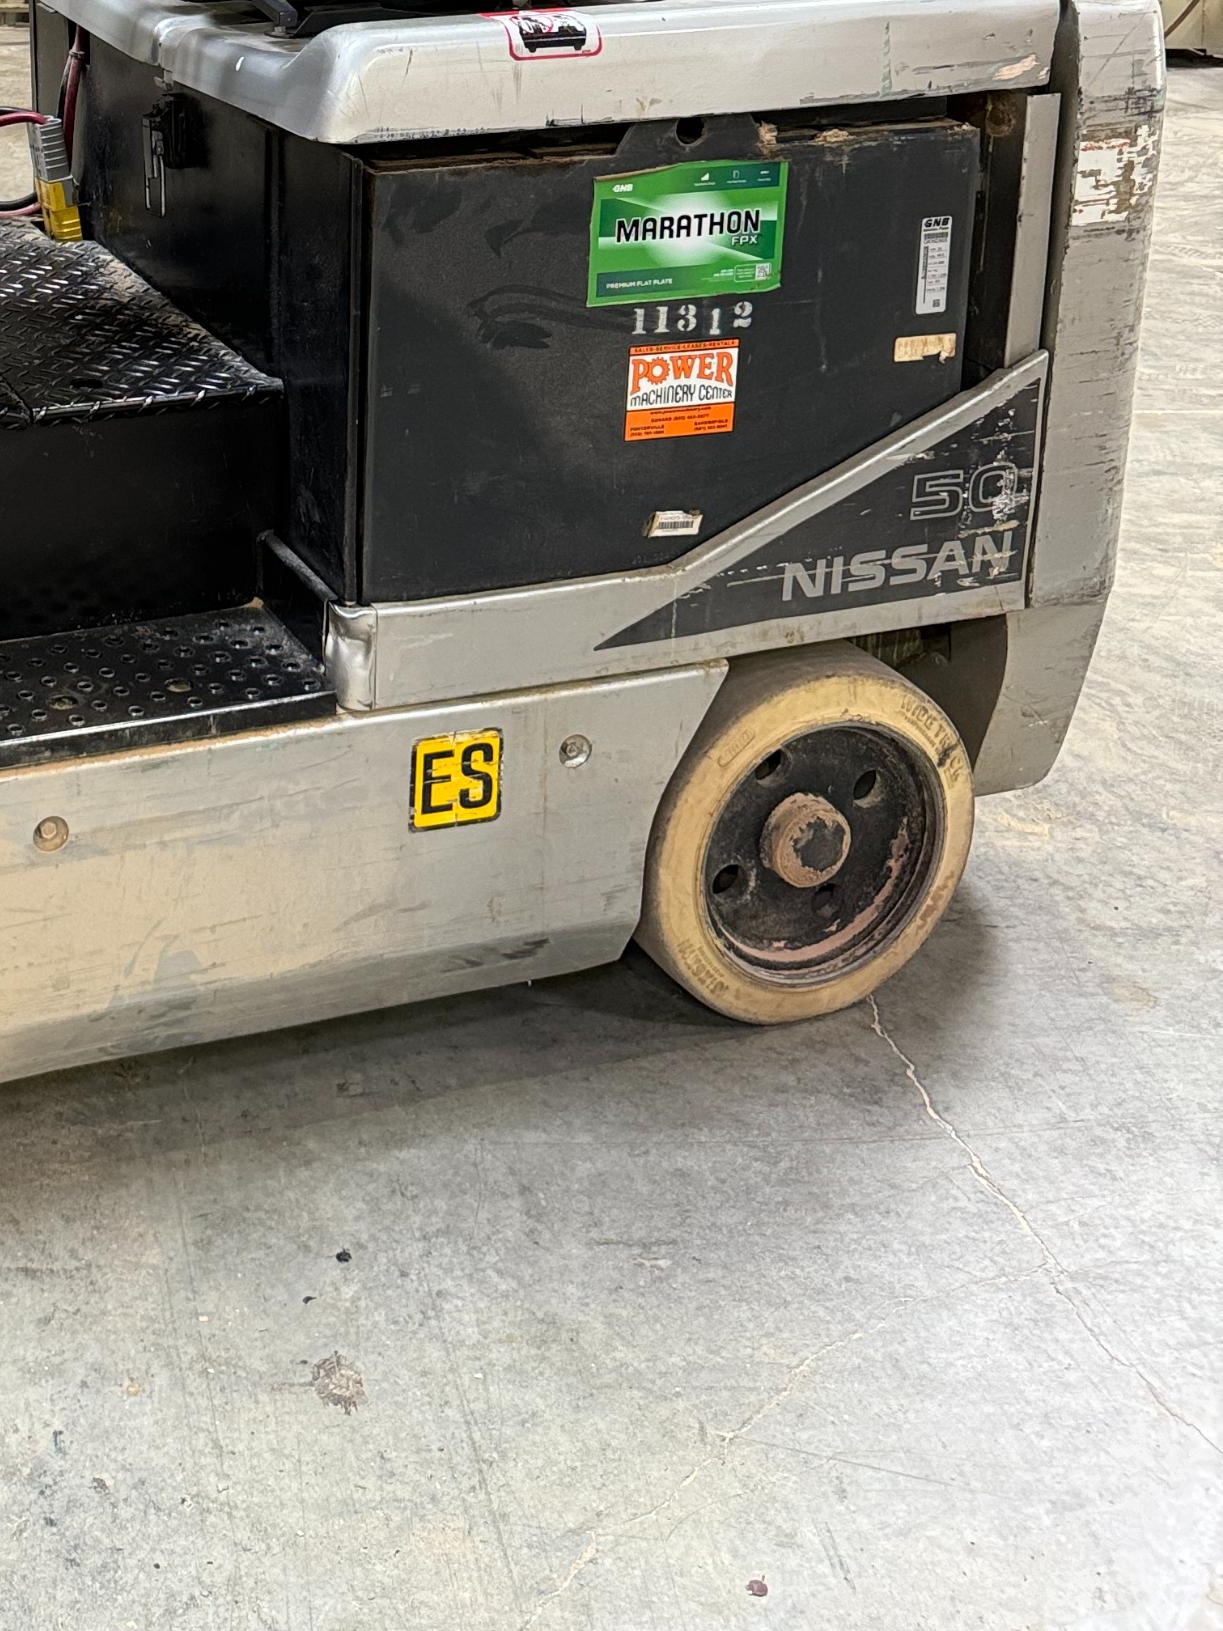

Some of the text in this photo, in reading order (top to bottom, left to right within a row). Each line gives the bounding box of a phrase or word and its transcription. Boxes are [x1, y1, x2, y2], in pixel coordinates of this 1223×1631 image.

[615, 209, 761, 243] MARATHON
[923, 217, 949, 228] GNB
[731, 234, 758, 246] FPX
[606, 281, 636, 289] PREMIUM
[636, 279, 652, 287] FLAT
[632, 301, 753, 335] 11312
[630, 351, 734, 396] POWER
[630, 383, 733, 407] MACHINERY CENTER
[910, 461, 1018, 520] 50
[782, 530, 1013, 602] NISSAN
[421, 742, 494, 815] ES
